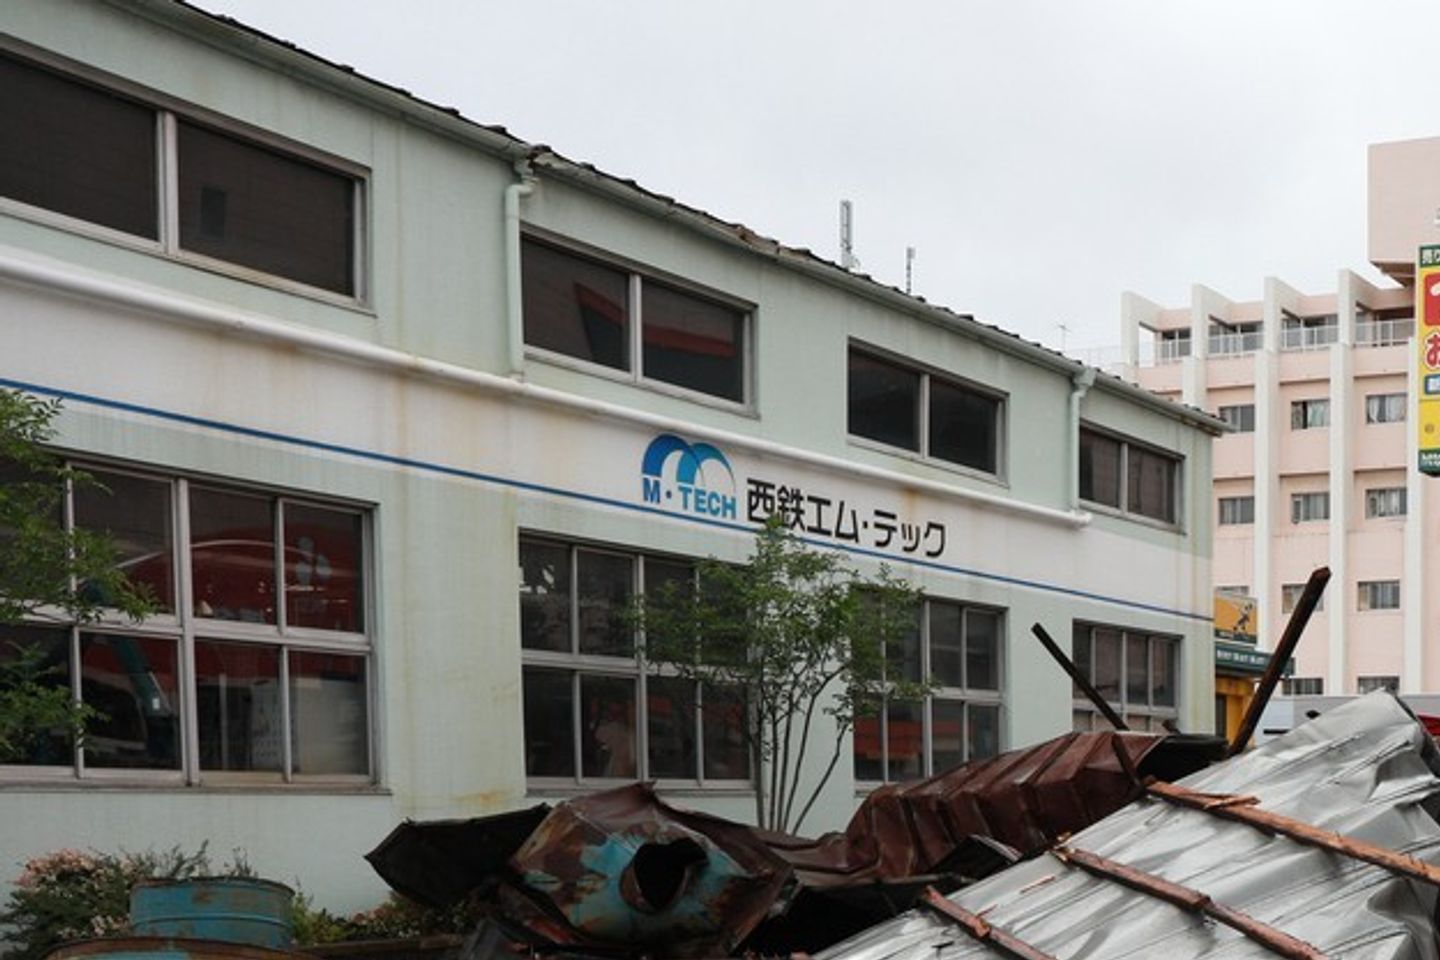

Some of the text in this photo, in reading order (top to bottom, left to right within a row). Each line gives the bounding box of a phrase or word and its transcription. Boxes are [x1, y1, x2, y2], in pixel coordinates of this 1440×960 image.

[746, 476, 946, 558] 西鉄エム・テック
